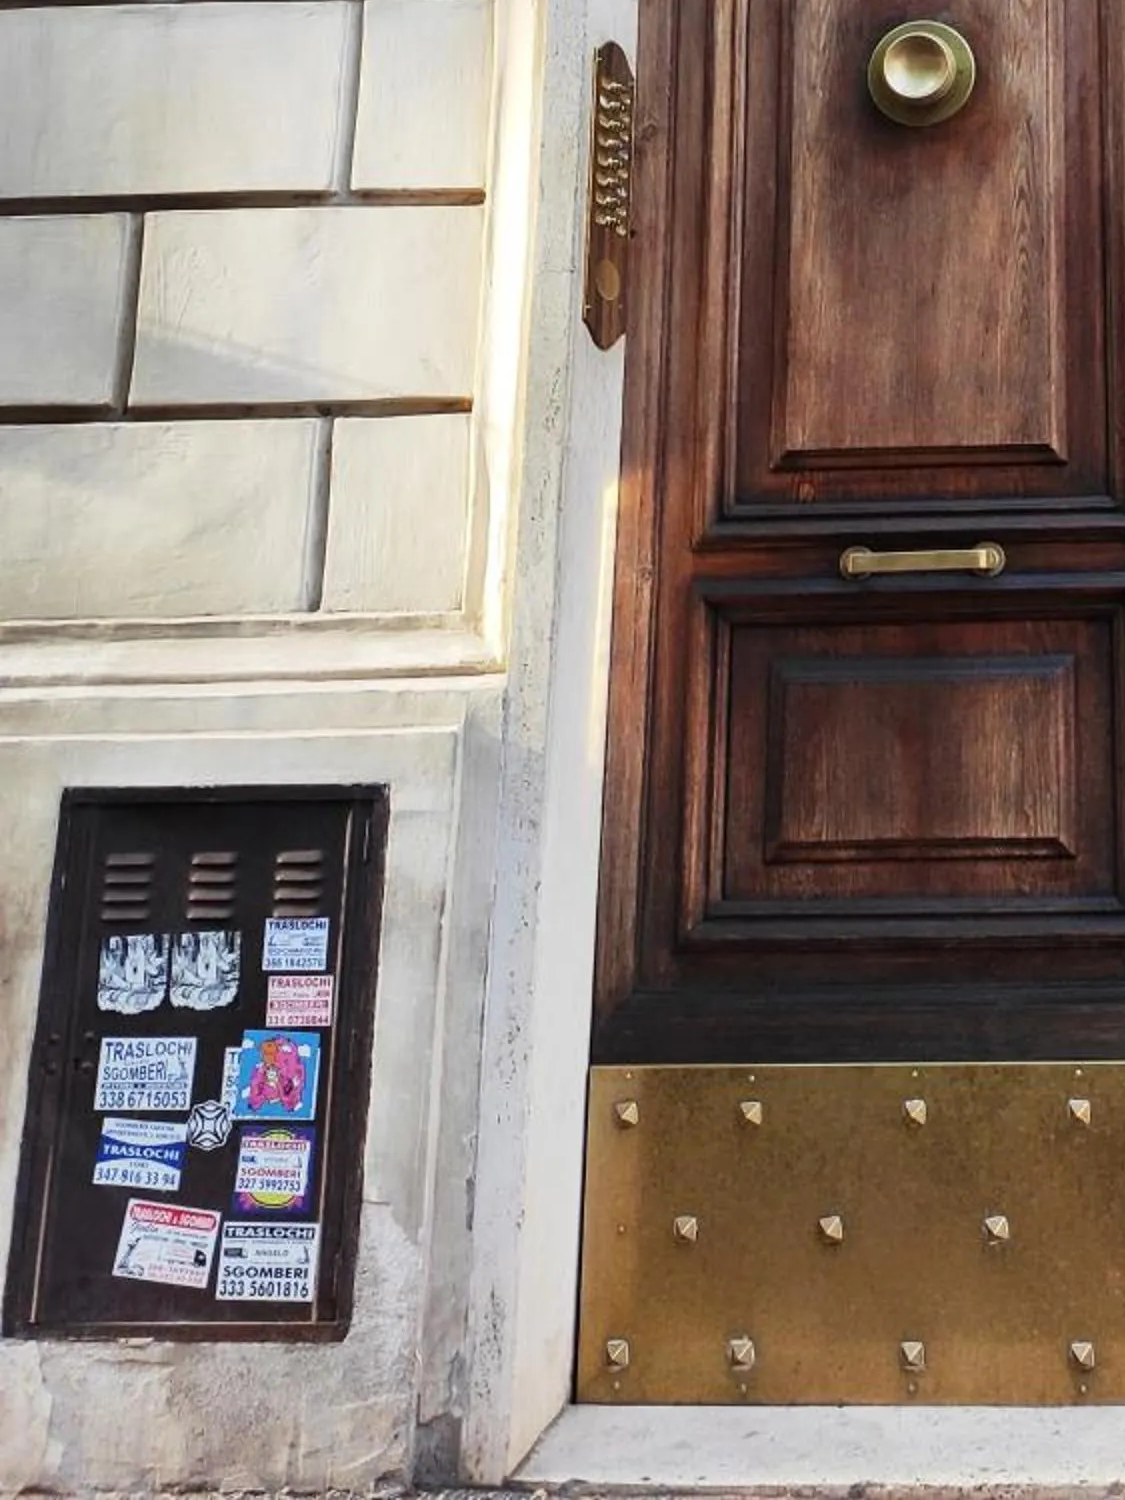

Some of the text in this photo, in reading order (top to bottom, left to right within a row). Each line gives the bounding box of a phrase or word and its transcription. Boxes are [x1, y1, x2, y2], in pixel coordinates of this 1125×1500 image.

[268, 920, 327, 931] TRASLOCHI
[271, 977, 331, 989] TRASLOCHI
[105, 1041, 193, 1063] TRASLOCHI
[103, 1061, 167, 1081] SGOMBERI
[99, 1091, 125, 1108] 338
[103, 1143, 180, 1161] TRASLOCHI
[144, 1171, 159, 1185] 33
[241, 1167, 301, 1178] SGOMBERI
[226, 1227, 315, 1239] TRASLOCHI
[223, 1265, 309, 1279] SGOMBERI
[220, 1280, 309, 1298] 333 5601816
